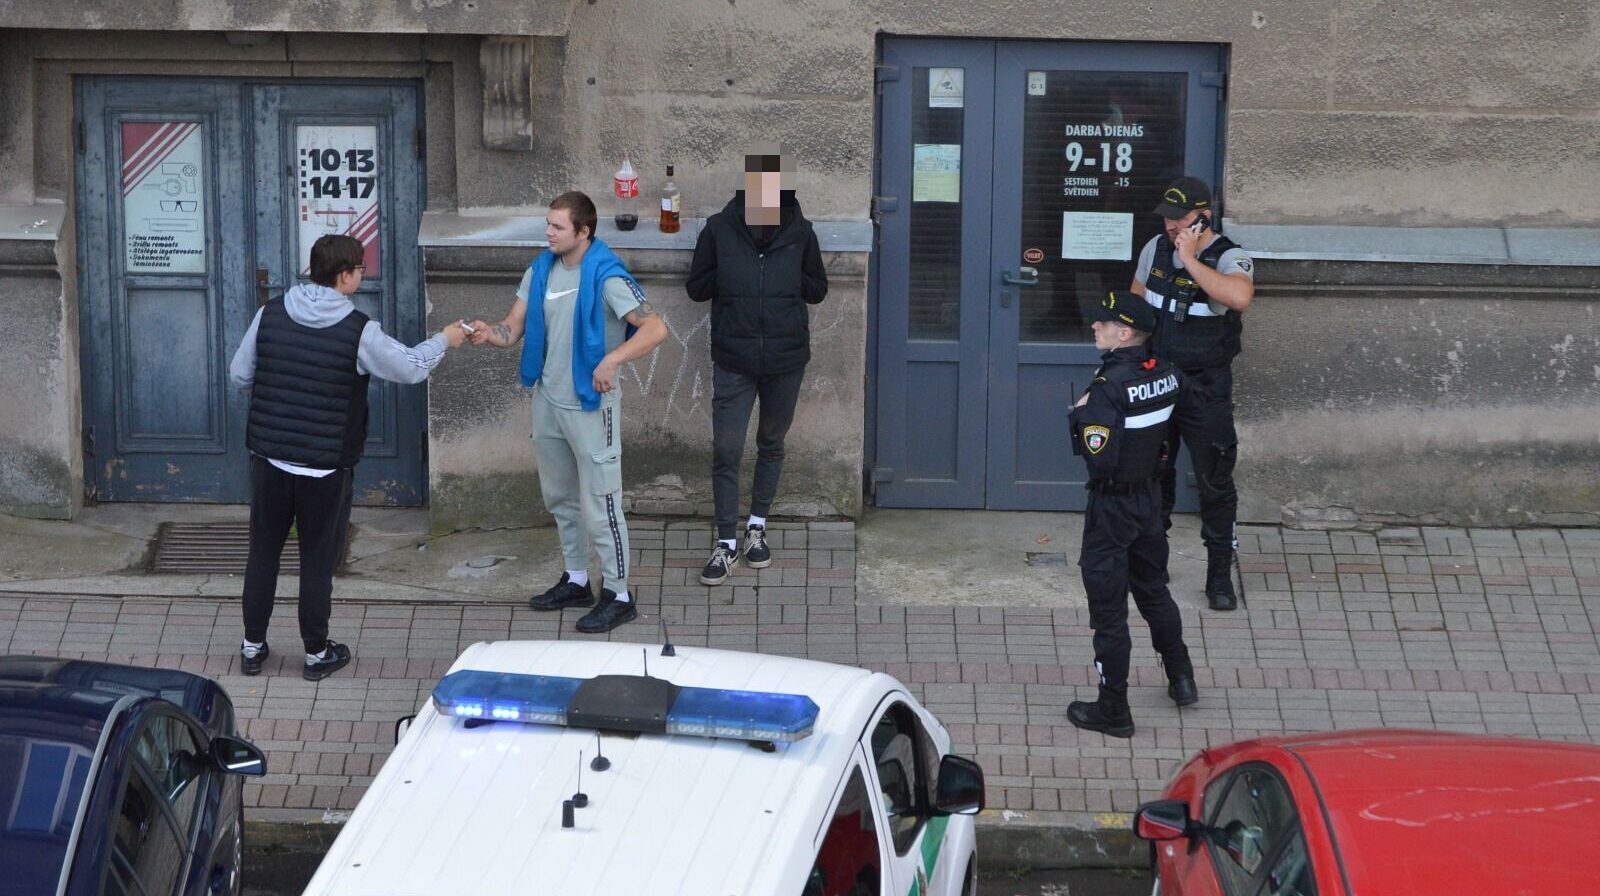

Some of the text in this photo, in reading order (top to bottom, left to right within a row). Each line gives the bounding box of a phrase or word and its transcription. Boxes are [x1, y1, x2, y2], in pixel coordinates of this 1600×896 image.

[1065, 123, 1144, 137] DARBA DIENĀS
[308, 148, 375, 172] 10-13
[1065, 141, 1133, 172] 9-18
[309, 176, 376, 198] 14-17
[1064, 177, 1098, 186] SESTDIEN
[1064, 186, 1099, 196] SVĒTDIEN
[1127, 373, 1179, 403] POLICIJA
